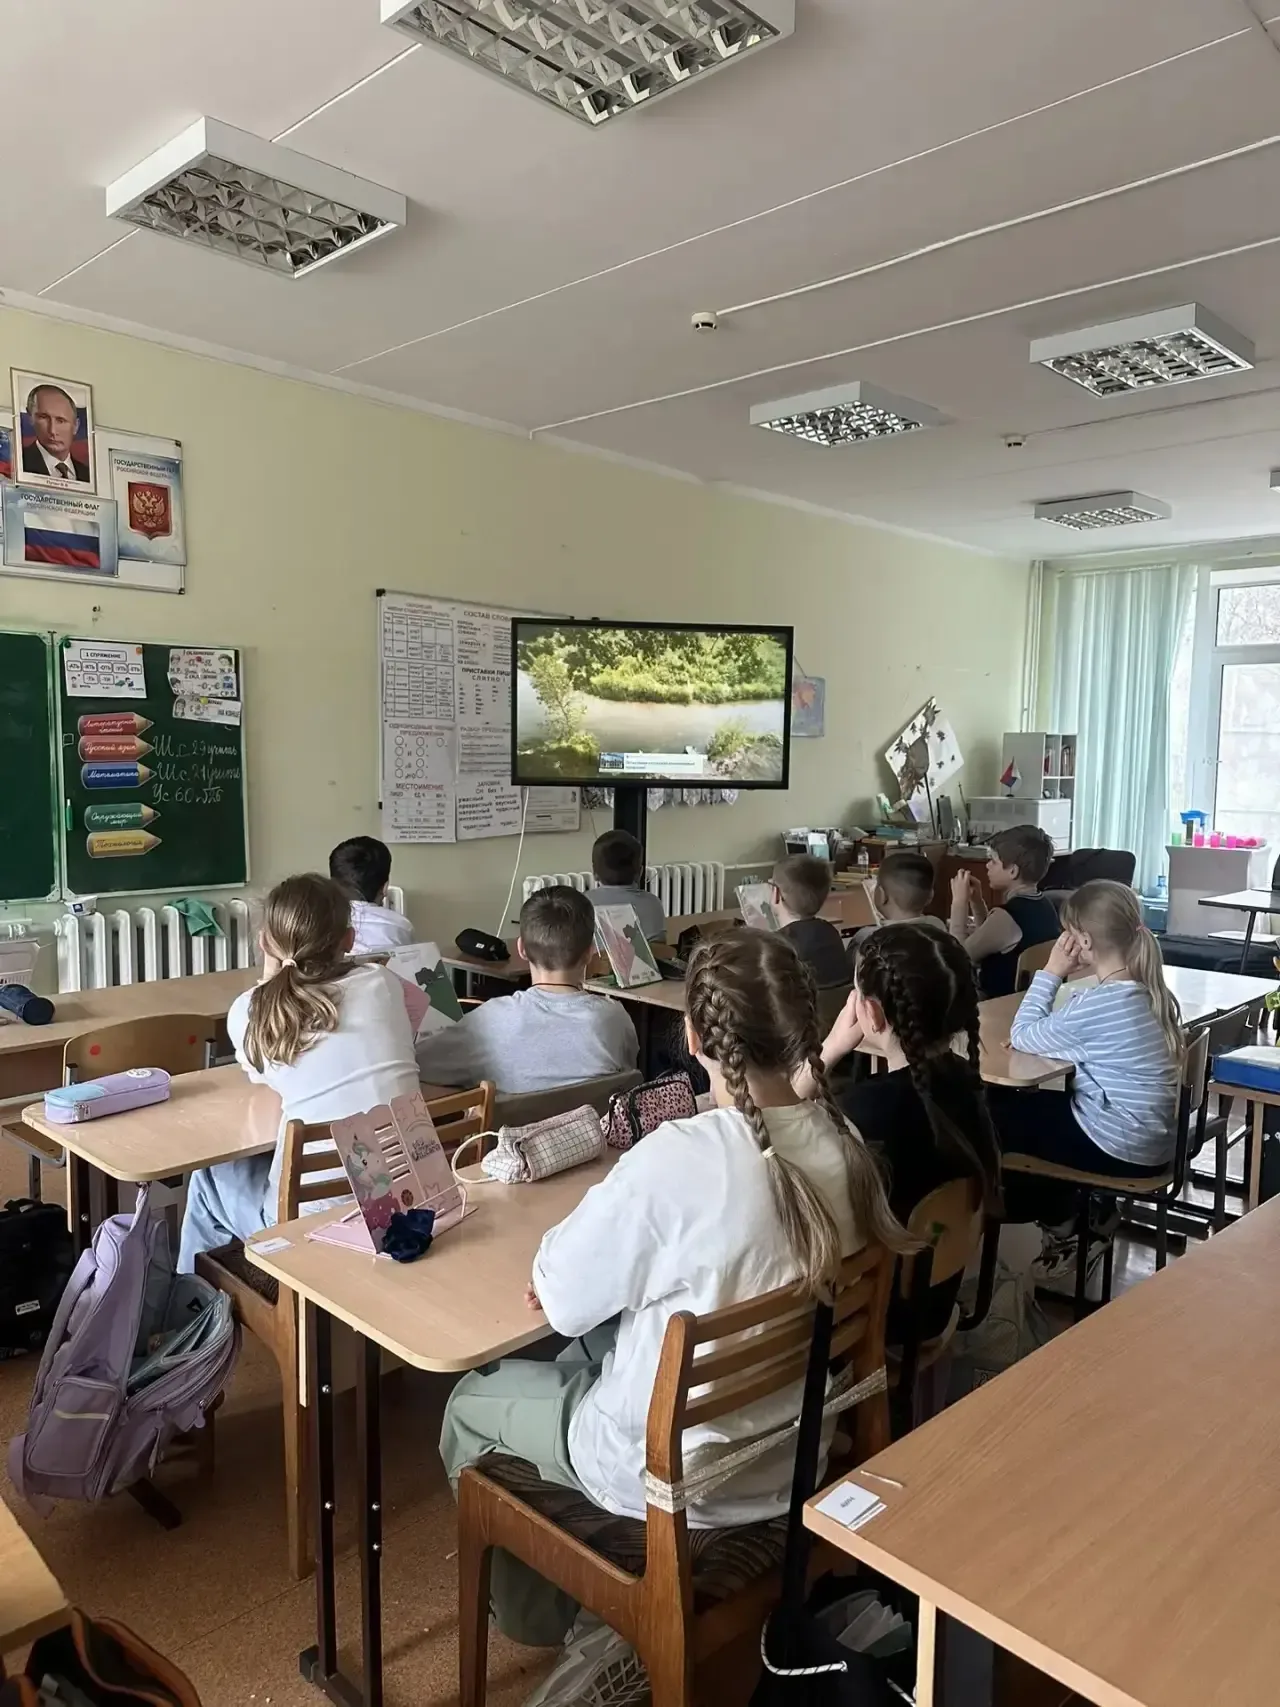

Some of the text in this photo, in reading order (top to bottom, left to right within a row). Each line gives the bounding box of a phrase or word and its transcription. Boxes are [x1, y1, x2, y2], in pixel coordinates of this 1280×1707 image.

[20, 493, 100, 511] ГОСУДАРСТВЕННЫЙ ФЛАГ
[84, 741, 136, 754] Русский язык
[88, 770, 139, 778] Математика
[396, 783, 445, 791] МЕСТОИМЕНИЕ
